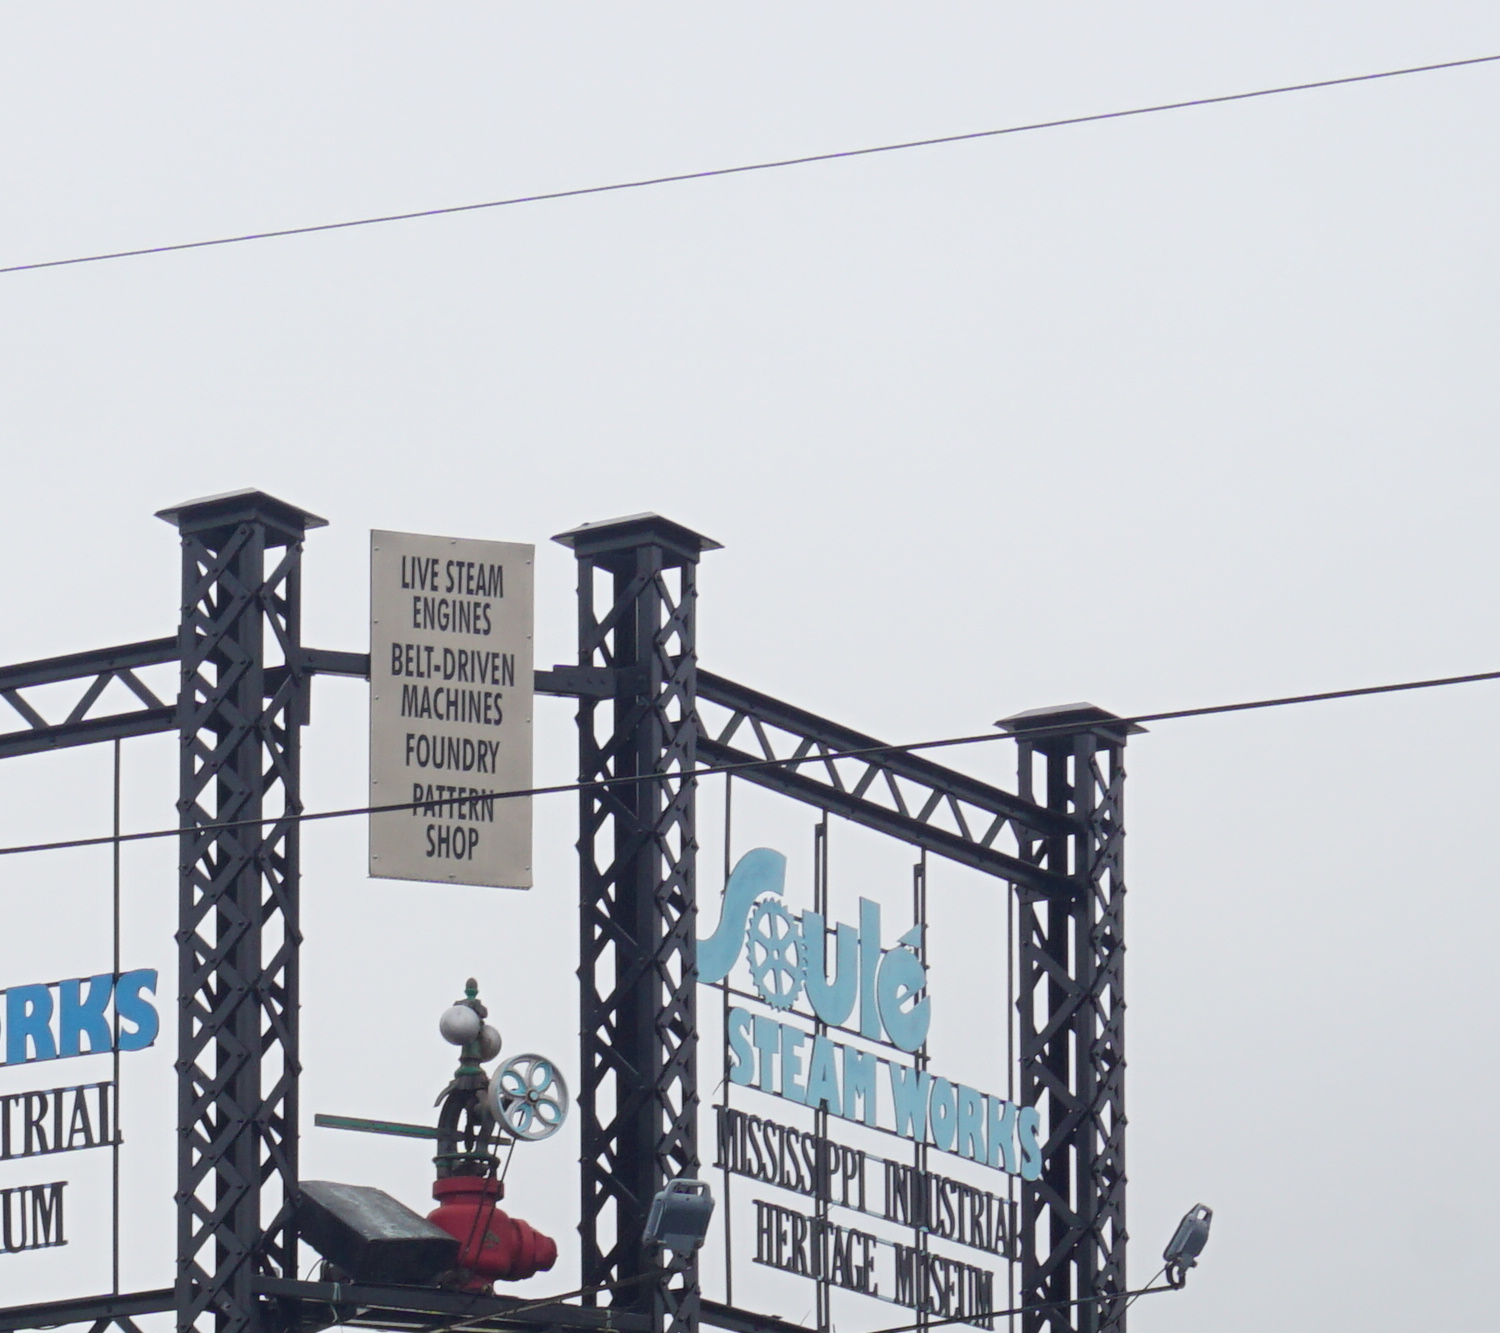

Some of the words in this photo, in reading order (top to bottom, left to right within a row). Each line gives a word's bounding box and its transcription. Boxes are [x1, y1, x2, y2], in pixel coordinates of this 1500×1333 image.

[401, 555, 439, 592] LIVE
[445, 560, 504, 599] STEAM
[412, 596, 492, 636] ENGINES
[391, 643, 515, 687] BELT-DRIVEN
[401, 684, 503, 726] MACHINES
[405, 733, 501, 774] FOUNDRY
[412, 783, 495, 823] PATTERN
[426, 824, 479, 860] SHOP
[727, 1005, 877, 1127] STEAM
[889, 1061, 1042, 1182] WORKS
[712, 1104, 866, 1210] MISSISSIPPI
[884, 1158, 1022, 1262] INDUSTRIAL
[752, 1199, 878, 1296] HERITAGE
[895, 1243, 994, 1331] MUSEUM
